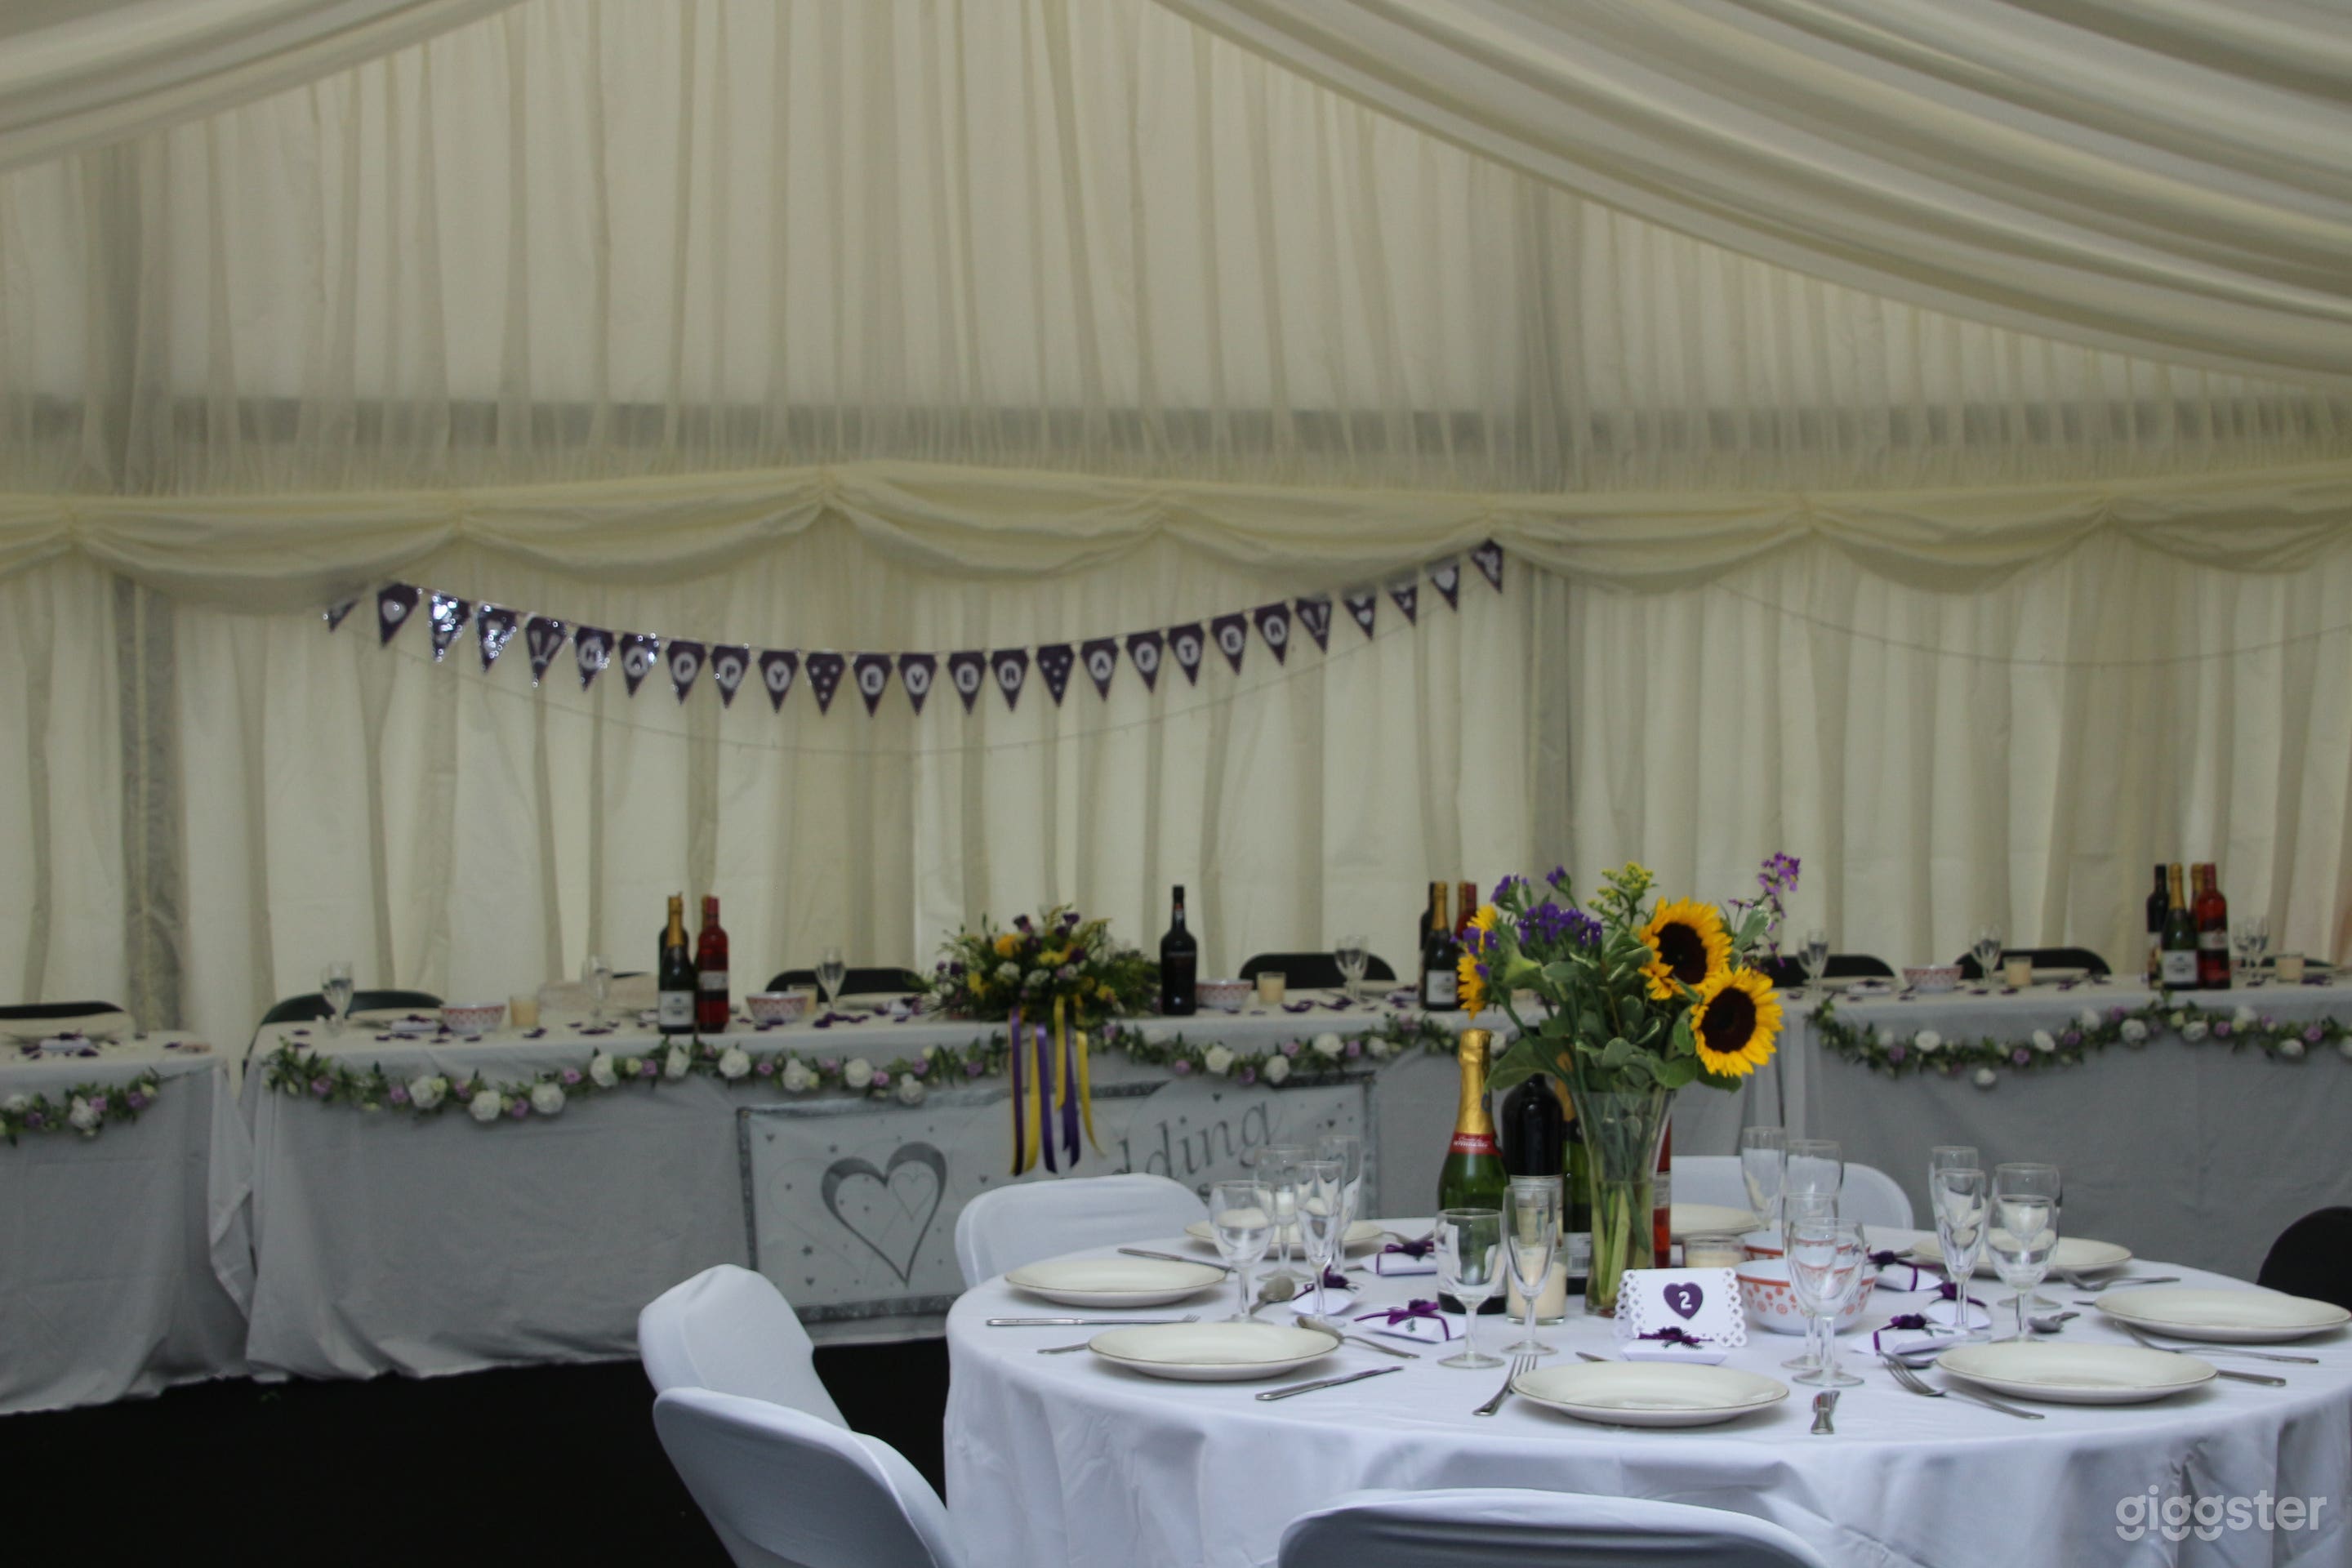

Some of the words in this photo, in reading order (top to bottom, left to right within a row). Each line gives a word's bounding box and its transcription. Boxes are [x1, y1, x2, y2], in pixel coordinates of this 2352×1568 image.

[581, 644, 788, 687] HAPPY
[864, 664, 1019, 689] EVER
[1094, 619, 1281, 672] AFTER
[1678, 1291, 1693, 1310] 2
